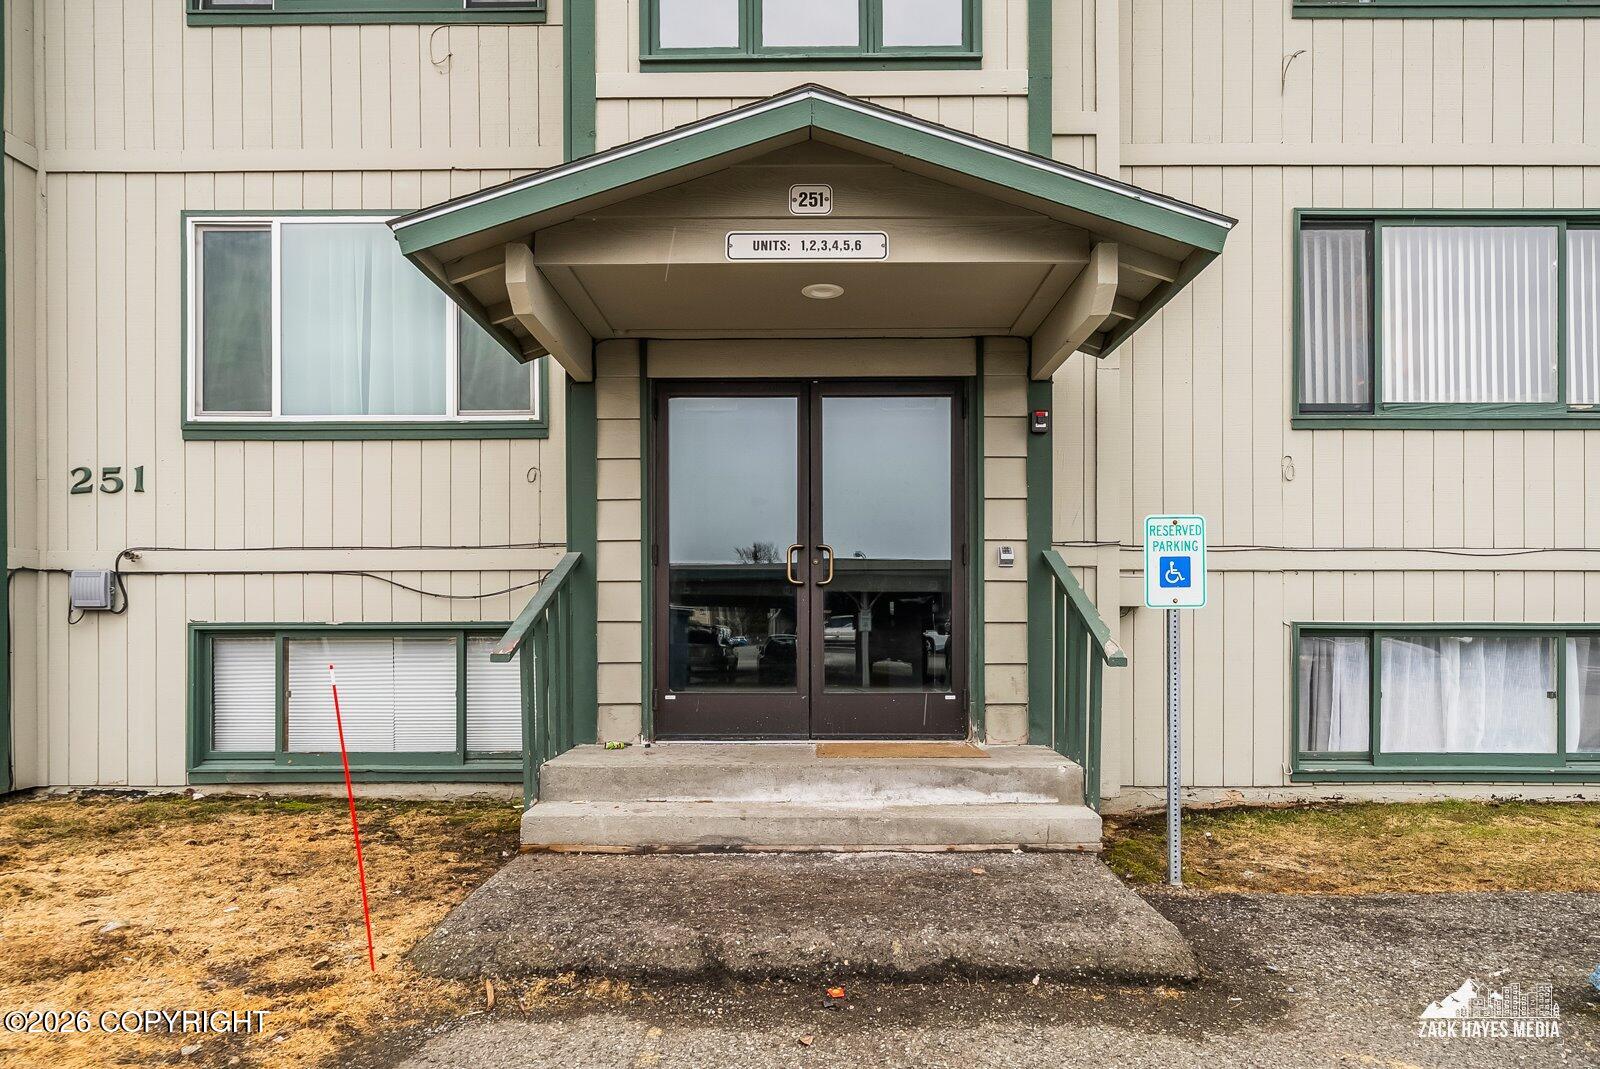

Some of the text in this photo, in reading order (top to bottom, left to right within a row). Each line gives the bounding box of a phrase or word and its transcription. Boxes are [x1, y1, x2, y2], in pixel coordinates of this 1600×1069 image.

[799, 192, 824, 207] 251
[753, 240, 862, 252] UNITS: 1,2,3,4,5,6
[70, 465, 145, 494] 251
[1149, 525, 1202, 536] RESERVED
[1152, 541, 1199, 552] PARKING
